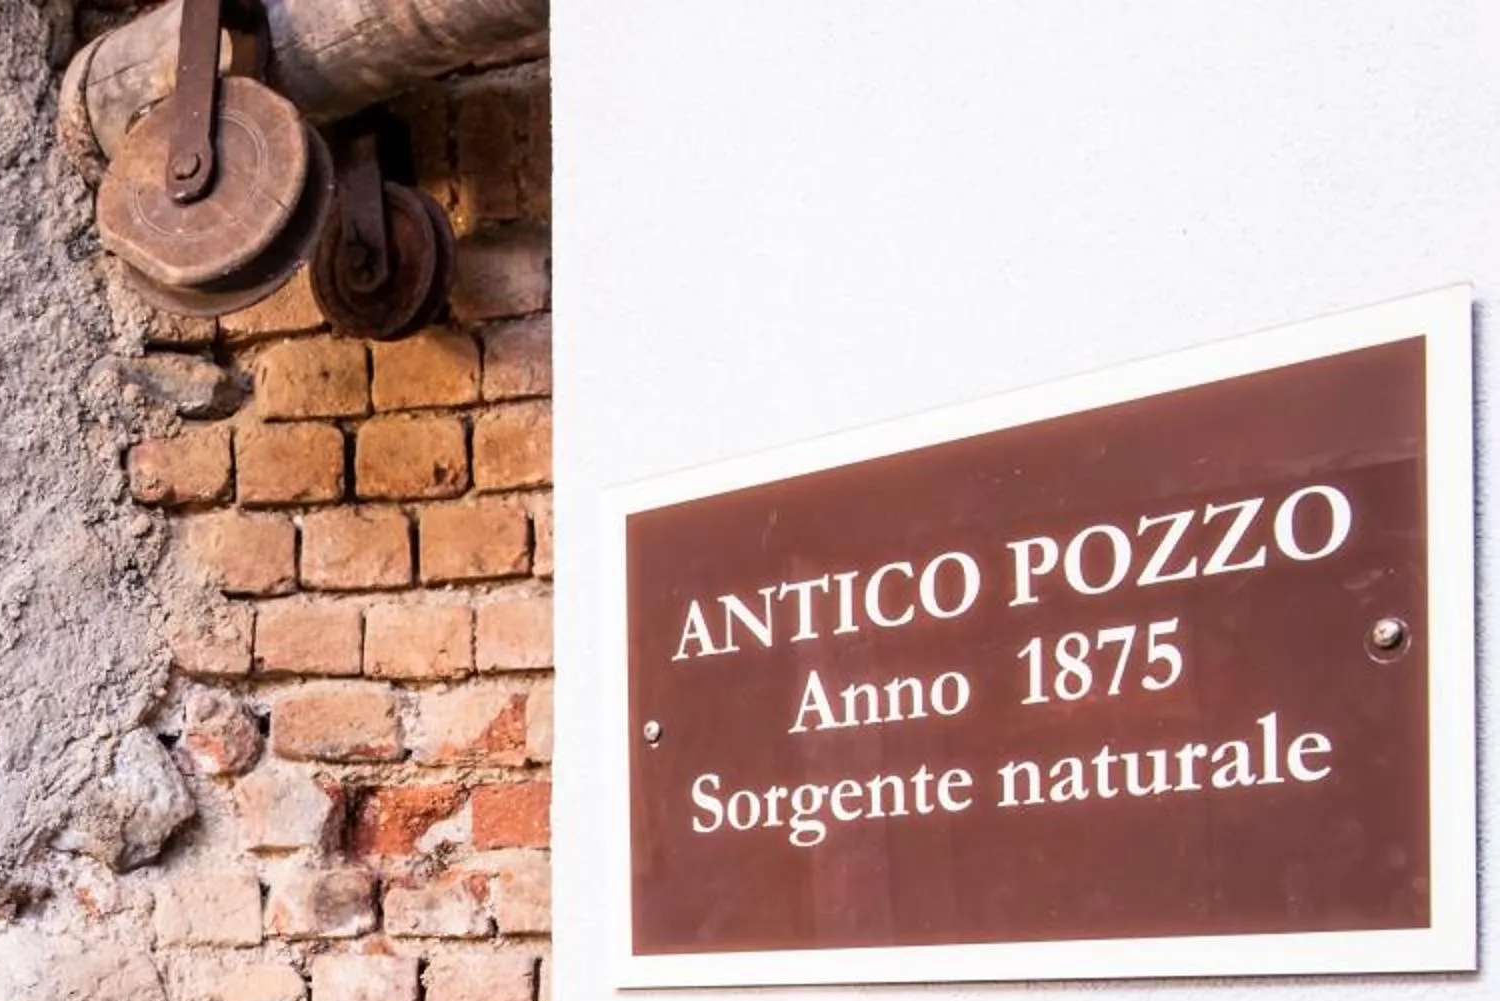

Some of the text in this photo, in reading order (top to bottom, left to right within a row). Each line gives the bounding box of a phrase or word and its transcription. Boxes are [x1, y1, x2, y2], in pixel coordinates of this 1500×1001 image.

[672, 485, 1352, 661] ANTICO POZZO
[787, 617, 1183, 734] Anno 1875
[691, 711, 1332, 847] Sorgente naturale
